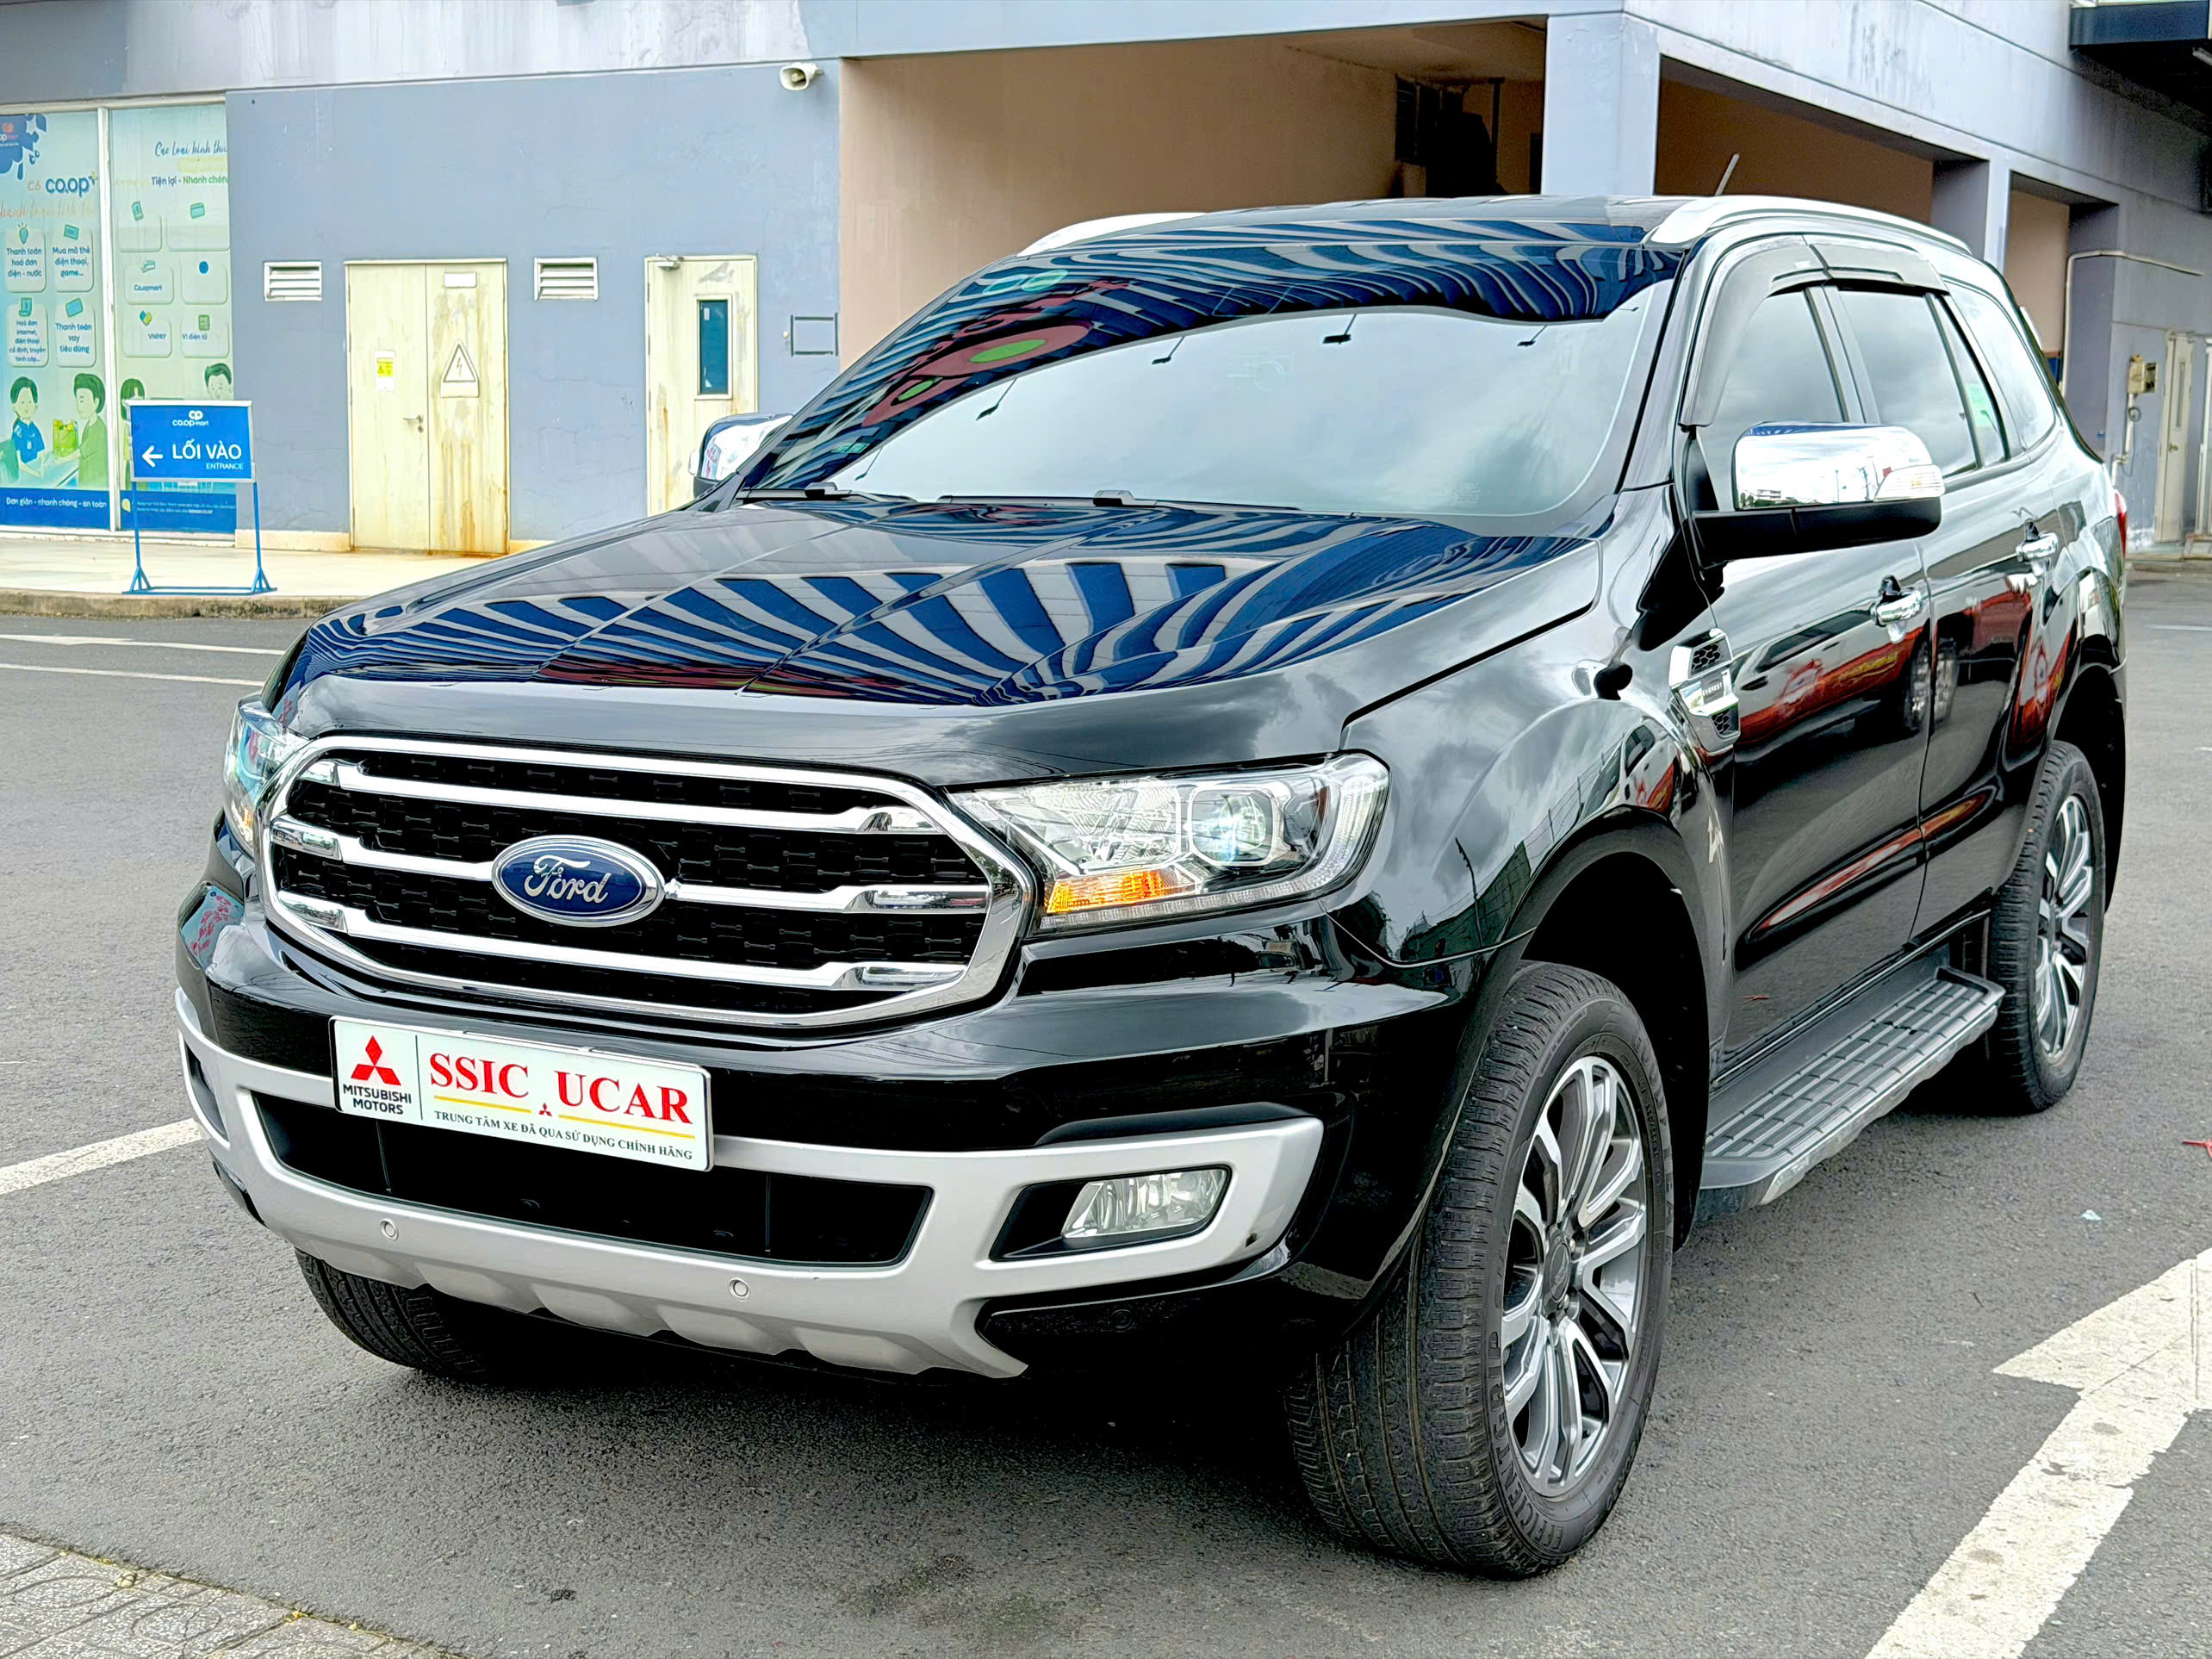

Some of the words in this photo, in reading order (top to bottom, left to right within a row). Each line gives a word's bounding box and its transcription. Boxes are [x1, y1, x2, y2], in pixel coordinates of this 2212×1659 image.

[151, 176, 167, 187] Tiện
[183, 174, 208, 184] Nhanh
[55, 322, 76, 331] Thanh
[172, 438, 201, 460] LỐI
[206, 440, 242, 460] VÀO
[525, 854, 612, 904] Ford
[343, 1084, 412, 1104] MITSUBISHI
[430, 1053, 529, 1098] SSIC
[554, 1070, 693, 1125] UCAR
[352, 1097, 404, 1115] MOTORS
[434, 1110, 473, 1125] TRUNG
[475, 1115, 500, 1129] TÂM
[503, 1121, 518, 1132] XE
[521, 1122, 537, 1134] ĐÃ
[539, 1127, 562, 1140] QUA
[583, 1134, 615, 1147] DỤNG
[618, 1140, 656, 1154] CHÍNH
